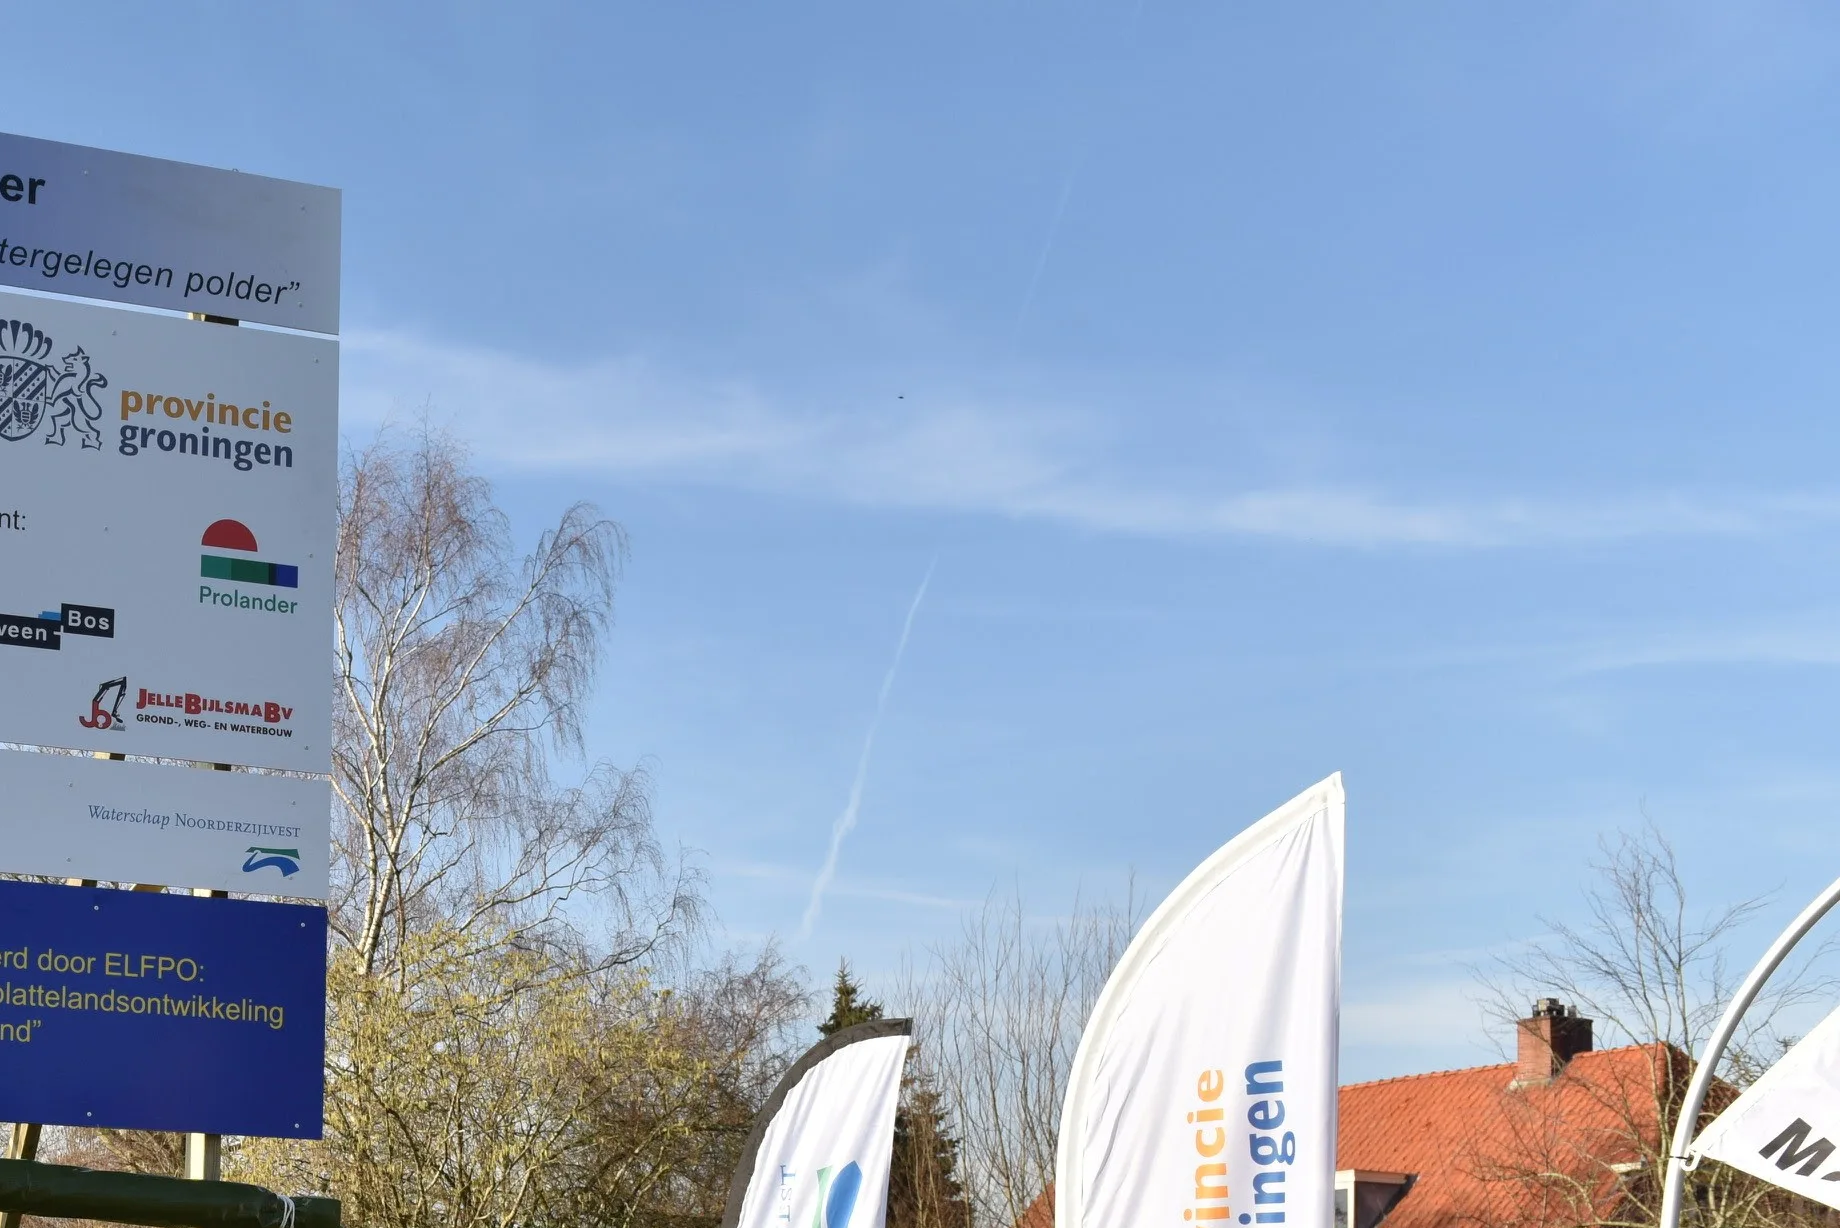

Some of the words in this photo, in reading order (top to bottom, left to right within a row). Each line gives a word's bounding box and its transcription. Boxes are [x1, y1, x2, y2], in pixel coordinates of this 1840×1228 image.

[184, 271, 300, 305] polder”
[120, 388, 293, 434] provincie
[119, 425, 293, 470] groningen
[199, 585, 298, 615] Prolander
[68, 609, 110, 630] Bos
[184, 719, 211, 729] WEG-
[214, 722, 227, 731] EN
[230, 724, 292, 738] WATERBOUW
[88, 805, 170, 829] Waterschap
[175, 813, 301, 838] NOORDERZIJLVEST
[37, 948, 97, 974] door
[105, 952, 205, 982] ELFPO:
[1758, 1117, 1840, 1182] M
